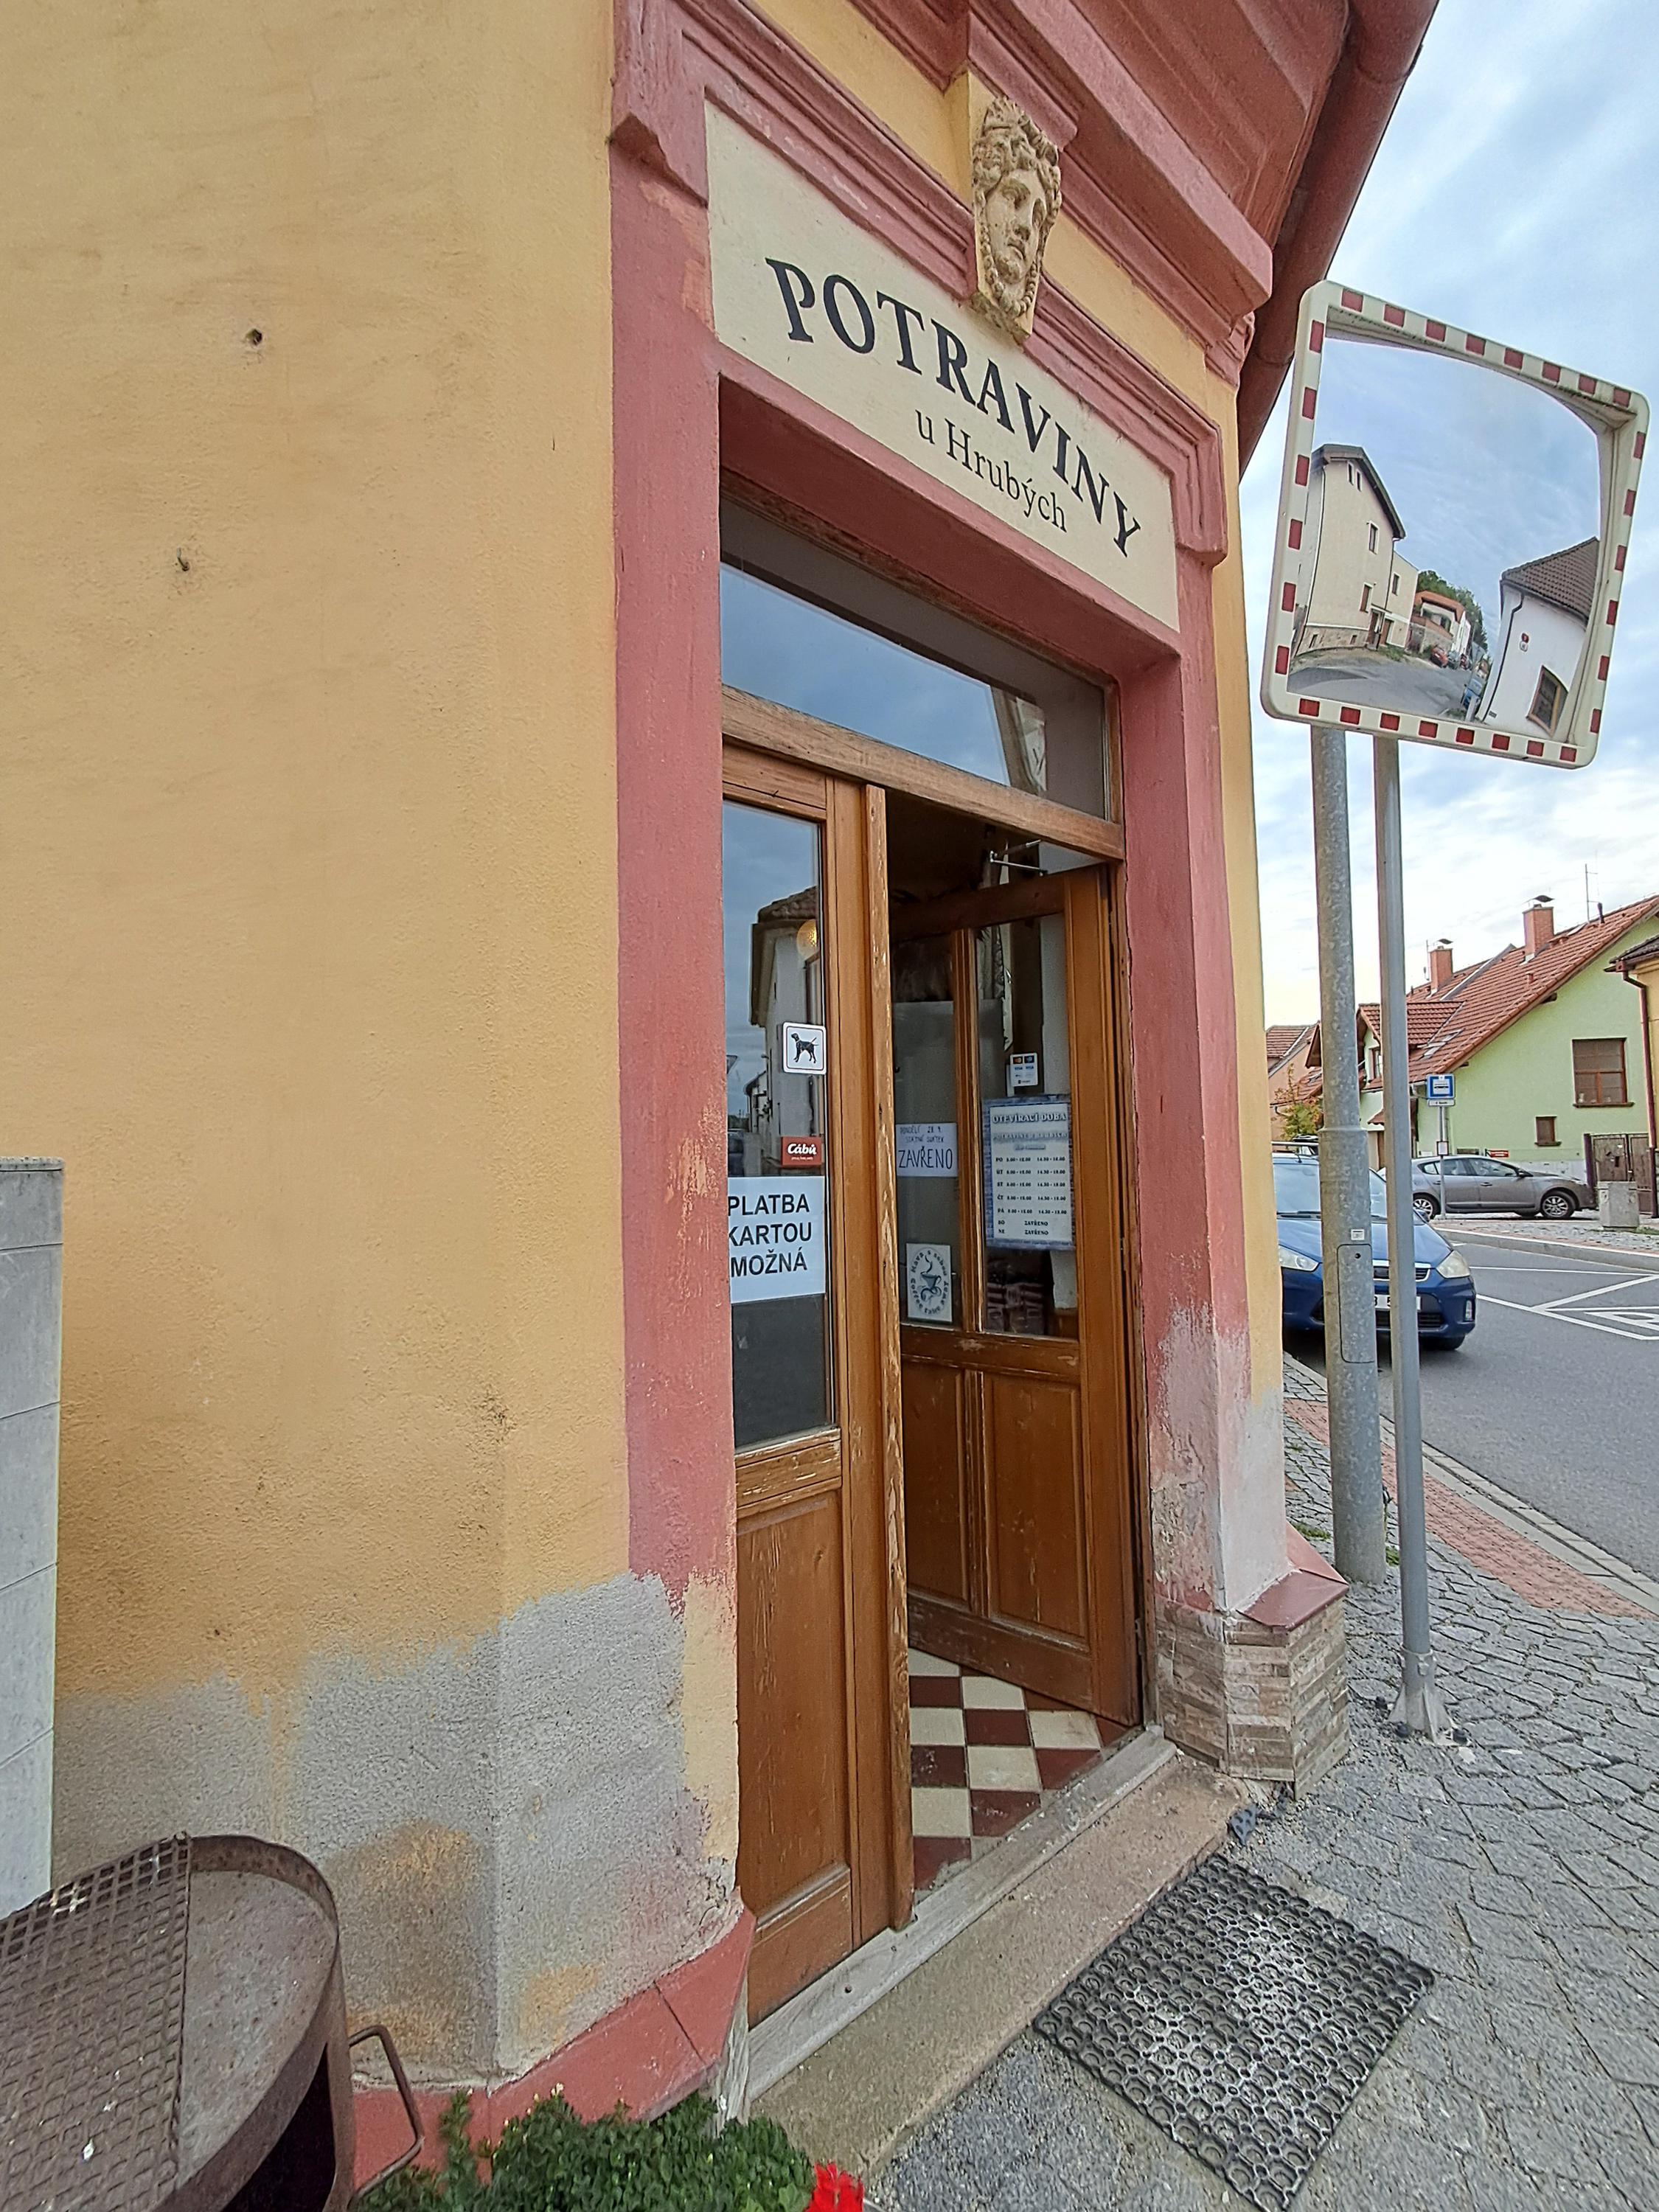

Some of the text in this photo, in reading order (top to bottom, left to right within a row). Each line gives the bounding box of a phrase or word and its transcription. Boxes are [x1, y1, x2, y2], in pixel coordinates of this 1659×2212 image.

[765, 257, 1141, 557] POTRAVINY
[915, 409, 1068, 533] u Hrubých
[992, 1112, 1067, 1124] OTEVÍRACÍ DOBA
[898, 1146, 953, 1169] ZAVŘENO
[728, 1193, 810, 1217] PLATBA
[728, 1222, 811, 1247] KARTOU
[731, 1246, 808, 1278] MOŽNÁ
